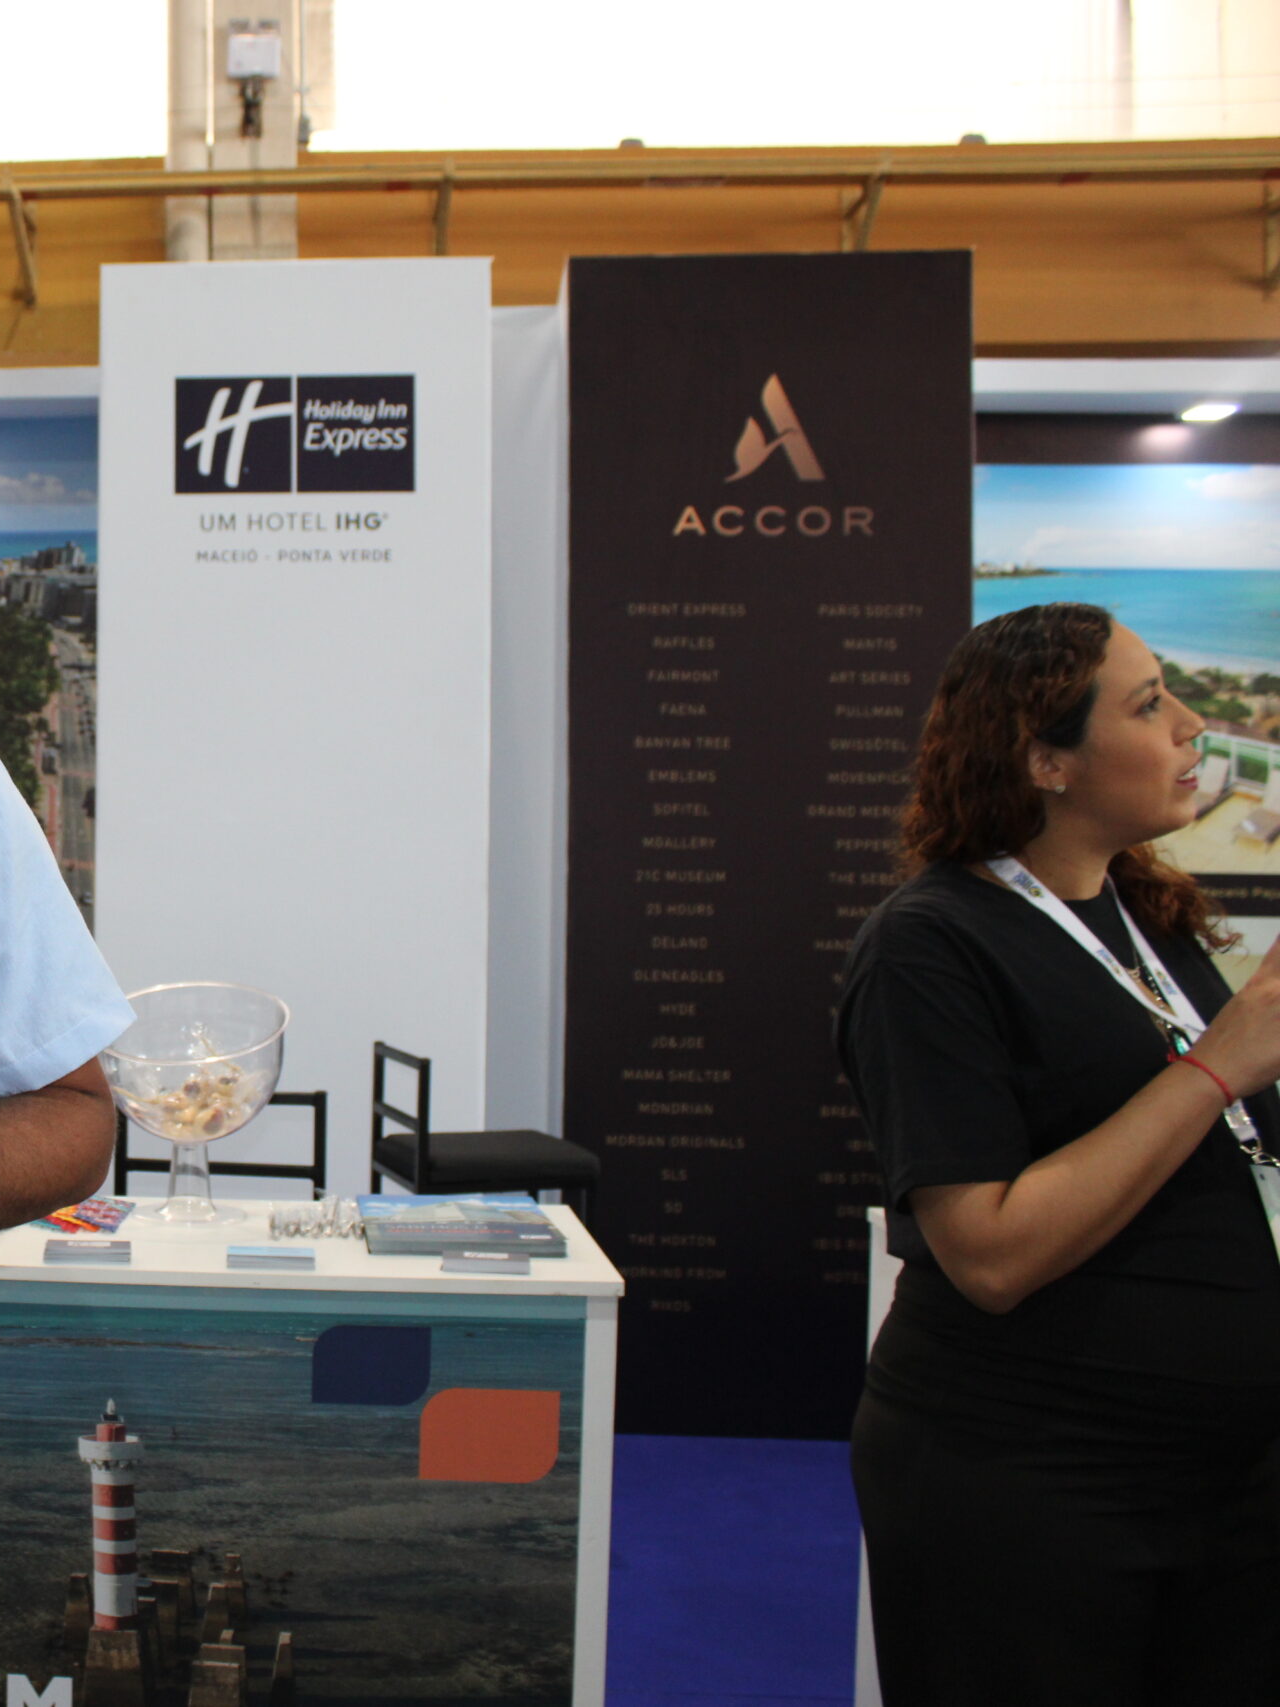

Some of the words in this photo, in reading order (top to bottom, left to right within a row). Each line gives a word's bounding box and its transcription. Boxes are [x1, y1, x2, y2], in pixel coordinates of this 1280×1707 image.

[304, 399, 374, 423] Holiday
[376, 399, 408, 419] Inn
[304, 423, 408, 456] Express
[199, 513, 237, 532] UM
[247, 512, 327, 532] HOTEL
[673, 505, 875, 537] ACCOR
[277, 548, 333, 562] PONTA
[338, 548, 393, 562] VERDE
[628, 602, 677, 616] ORIENT
[683, 602, 746, 616] EXPRESS
[818, 604, 861, 617] PARIS
[865, 604, 923, 617] SOCIETY
[653, 635, 715, 649] RAFFLES
[842, 638, 898, 651] MANTIS
[647, 669, 719, 682] FAIRMONT
[830, 671, 856, 684] ART
[861, 671, 911, 685] SERIES
[835, 704, 904, 717] PULLMAN
[634, 736, 691, 749] BANYAN
[696, 736, 731, 749] TREE
[648, 769, 717, 783] EMBLEMS
[653, 803, 710, 816] SOFITEL
[808, 805, 856, 818] GRAND
[666, 869, 727, 882] MUSEUM
[667, 903, 715, 916] HOURS
[623, 1069, 664, 1081] MAMA
[669, 1069, 732, 1082] SHELTER
[639, 1102, 714, 1115] MONDRIAN
